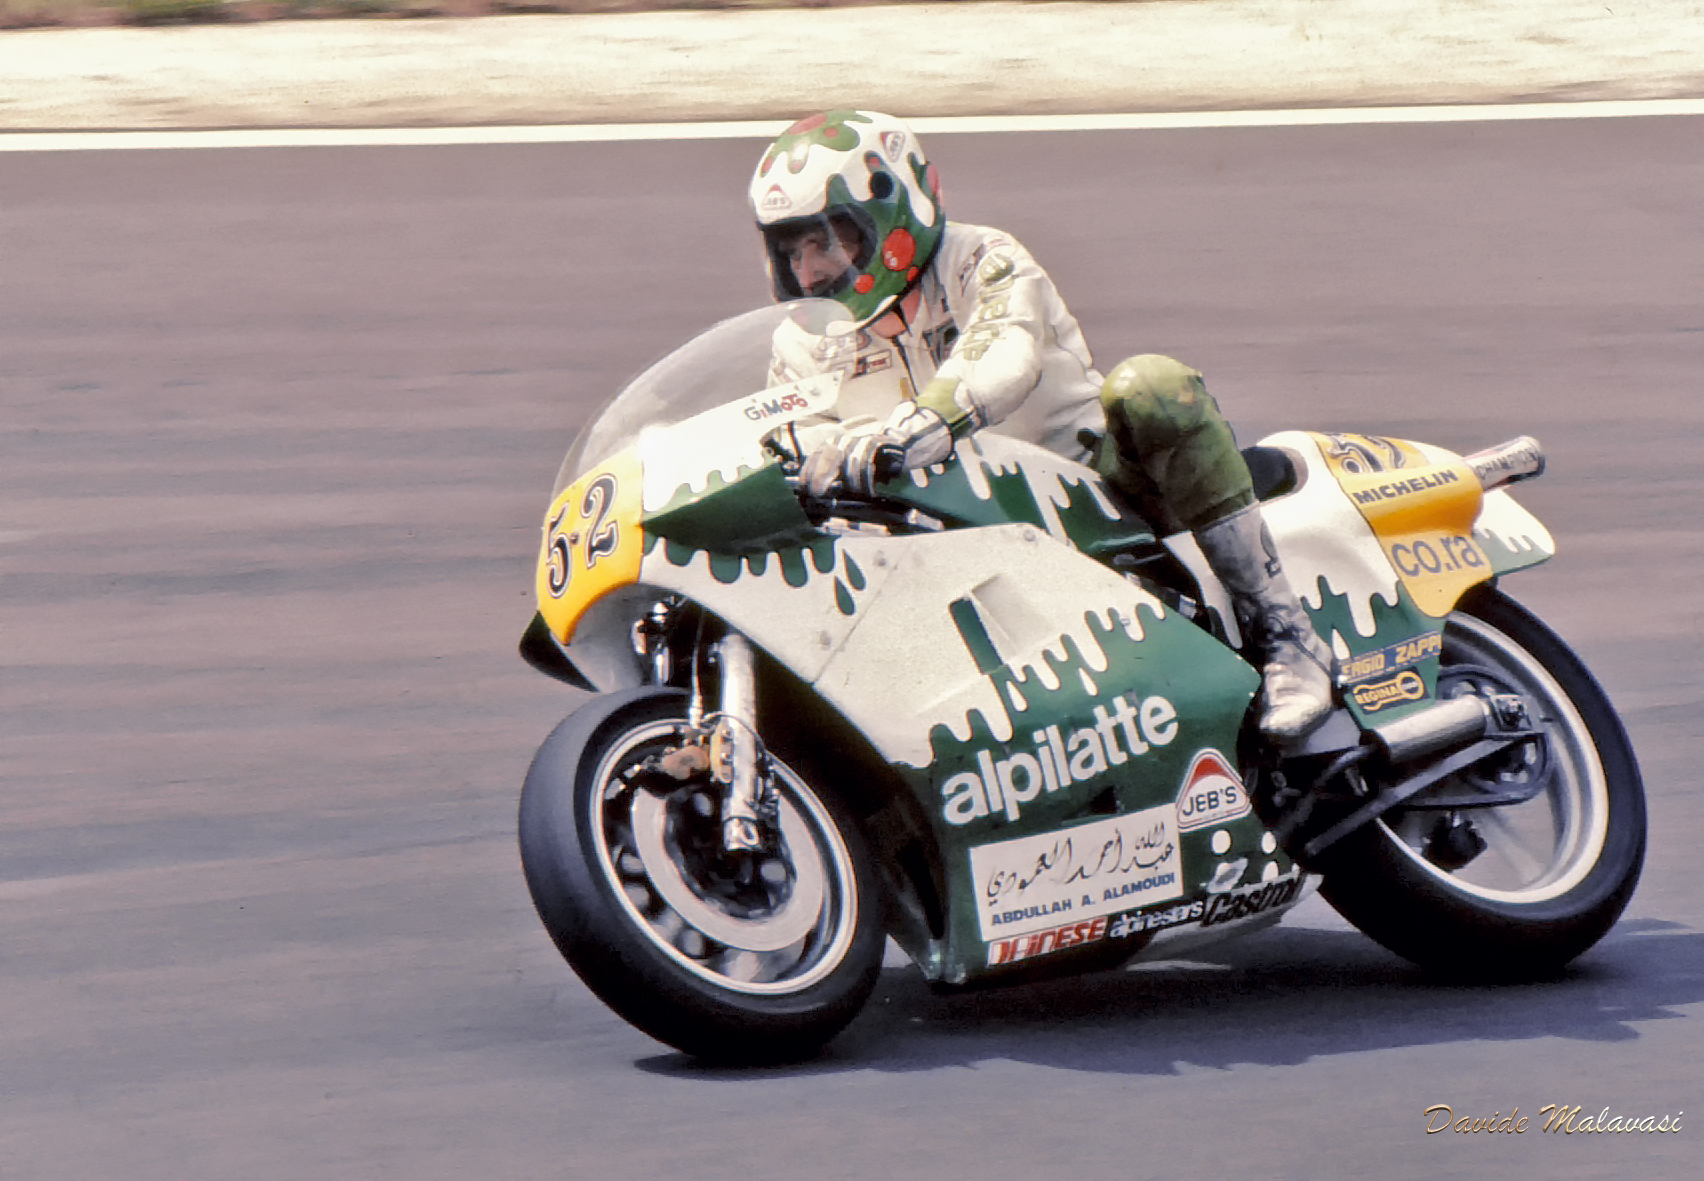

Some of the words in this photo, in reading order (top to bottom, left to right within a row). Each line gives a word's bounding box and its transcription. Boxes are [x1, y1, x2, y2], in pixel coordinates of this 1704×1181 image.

[1352, 469, 1459, 504] MICHELIN
[545, 472, 620, 600] 52
[1354, 685, 1402, 704] REGINA
[942, 695, 1180, 823] alpilatte
[1182, 786, 1238, 816] JEB'S
[991, 898, 1073, 927] ABDULLAH
[1081, 894, 1096, 907] A.
[1103, 872, 1175, 902] ALAMOUDI
